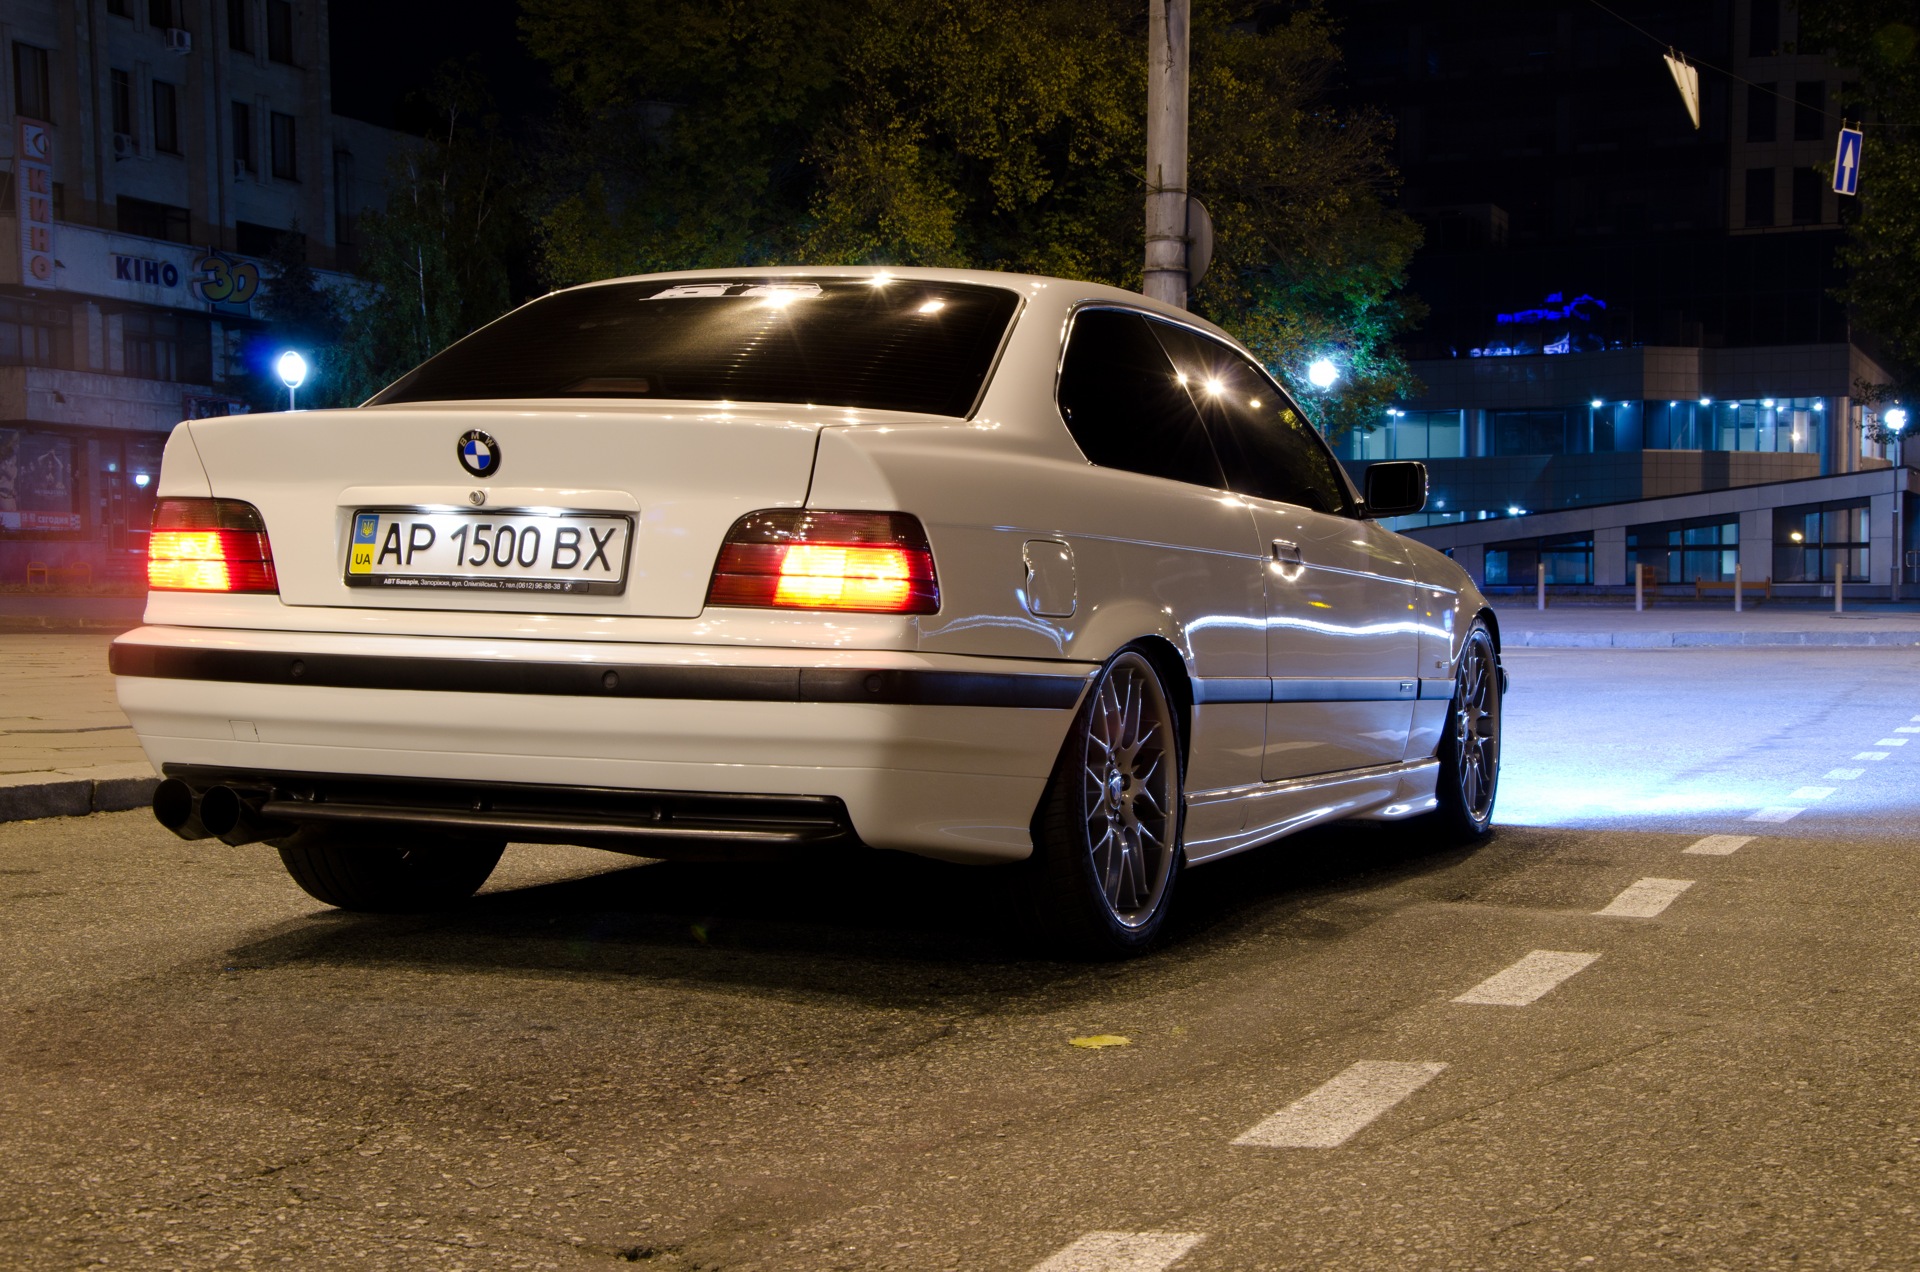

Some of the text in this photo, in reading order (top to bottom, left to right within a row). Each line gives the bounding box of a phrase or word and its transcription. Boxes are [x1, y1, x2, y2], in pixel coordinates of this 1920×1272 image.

[29, 167, 51, 281] КИНО
[116, 256, 260, 304] КІНО 3D
[459, 431, 495, 448] BMW
[355, 553, 371, 566] UA
[377, 522, 617, 572] AP 1500 BX
